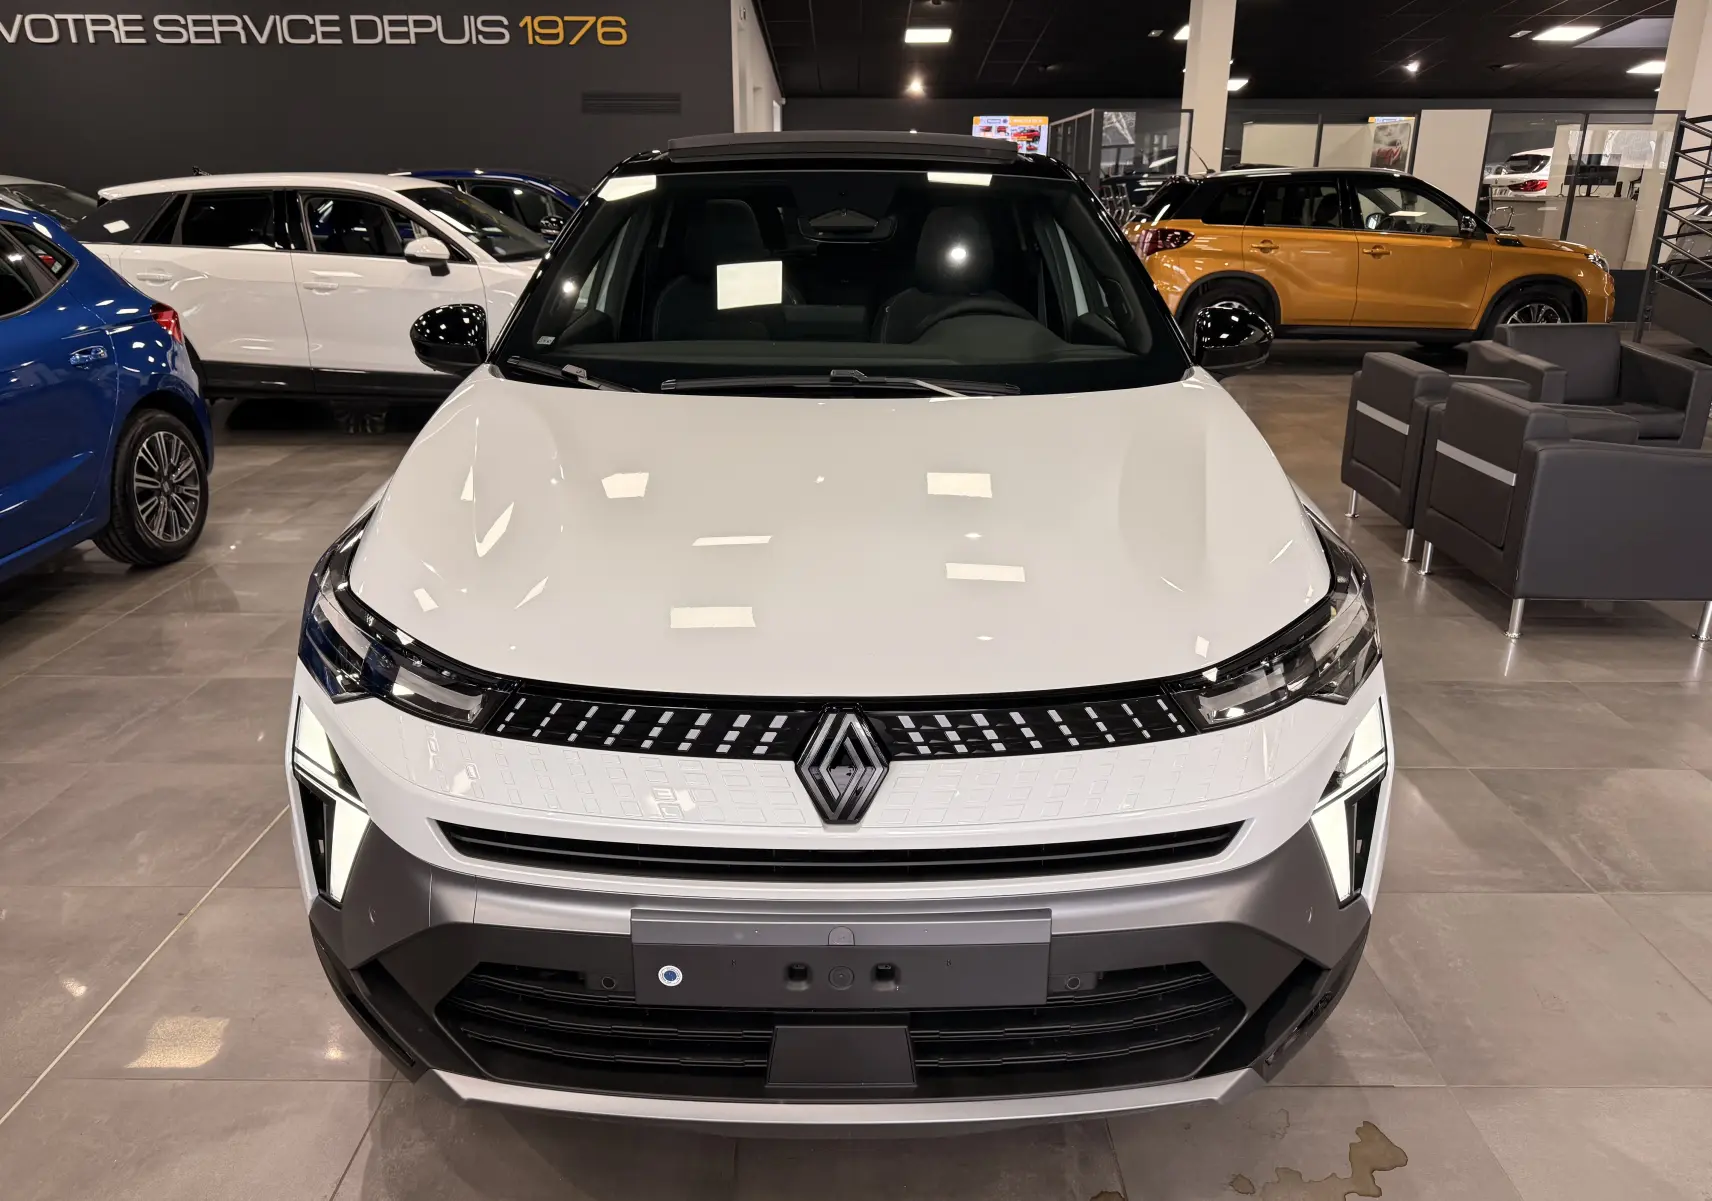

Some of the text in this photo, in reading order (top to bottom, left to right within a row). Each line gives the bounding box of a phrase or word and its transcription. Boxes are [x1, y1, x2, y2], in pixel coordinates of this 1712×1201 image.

[0, 14, 628, 45] VOTRE SERVICE DEPUIS 1976
